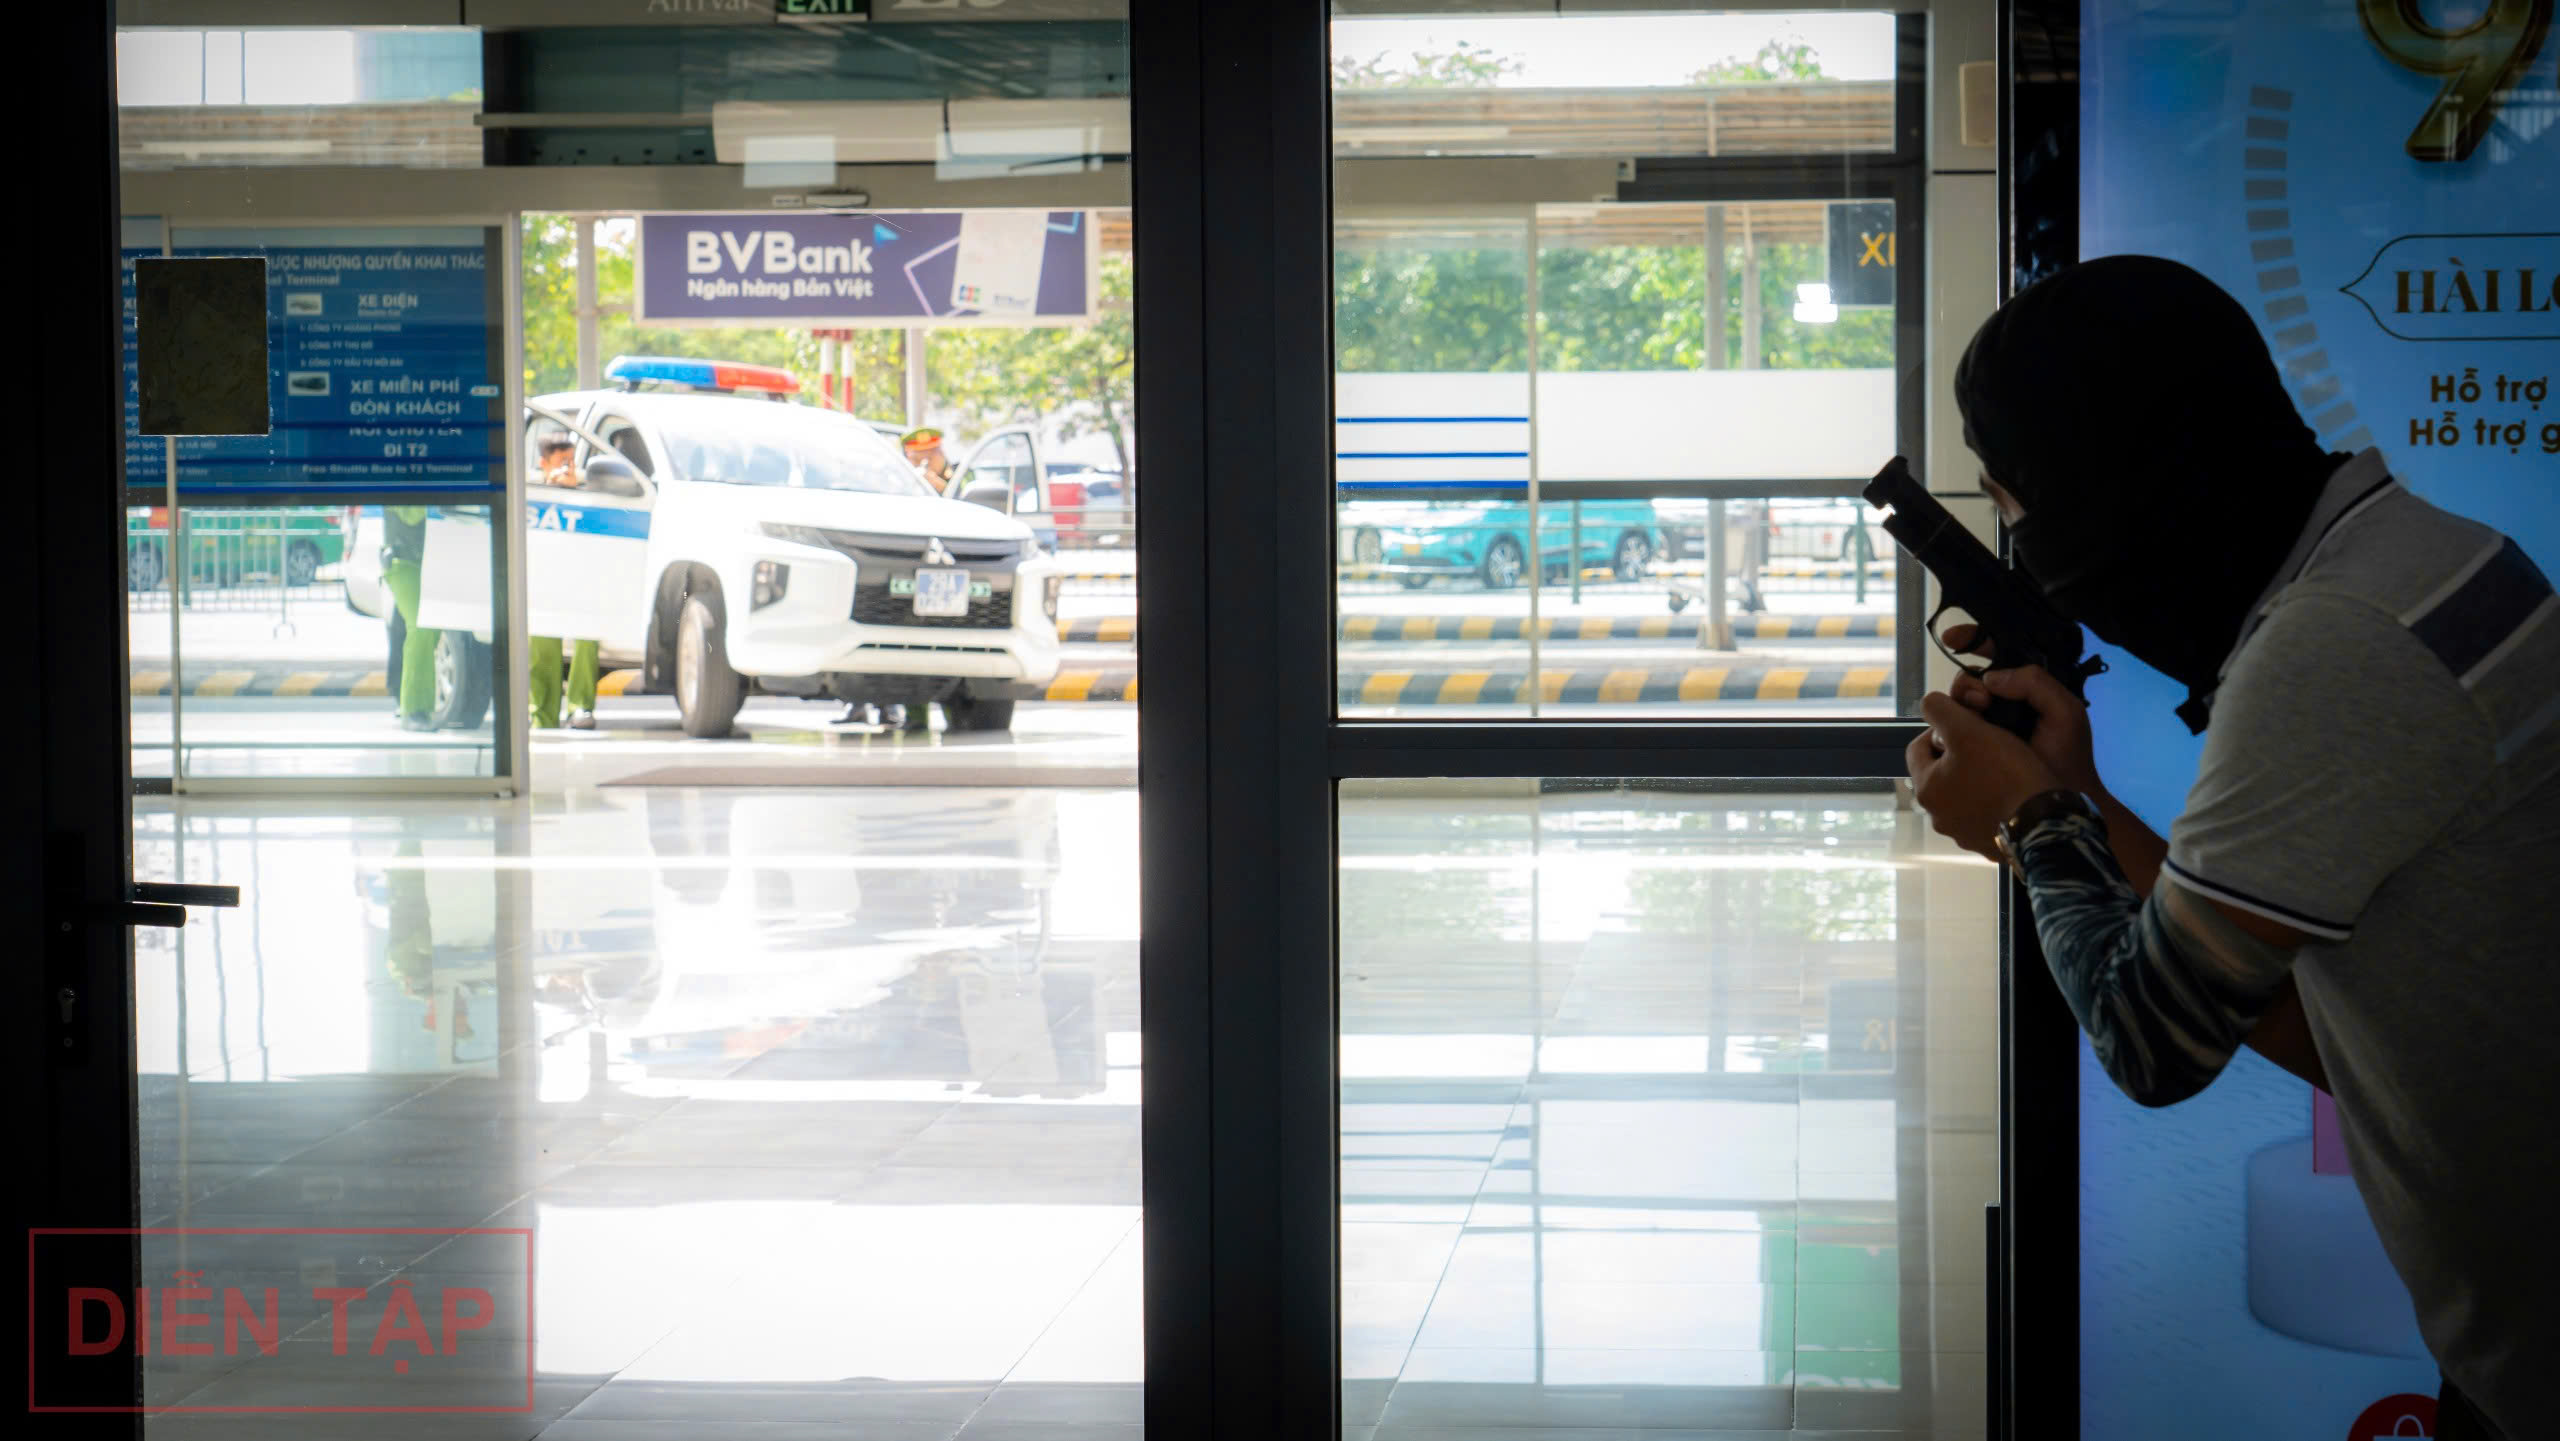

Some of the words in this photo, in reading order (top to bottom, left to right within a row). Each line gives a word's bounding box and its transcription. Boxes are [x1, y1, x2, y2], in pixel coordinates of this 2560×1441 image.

[787, 0, 854, 14] EXIT
[364, 250, 411, 271] QUYỀN
[414, 254, 447, 270] KHAI
[449, 251, 485, 270] THÁC
[687, 231, 873, 274] BVBank
[687, 277, 739, 300] Ngân
[742, 277, 790, 300] hàng
[793, 276, 831, 297] Bản
[833, 278, 873, 300] Việt
[2394, 256, 2502, 313] HÀI
[2516, 268, 2560, 313] L
[358, 294, 377, 308] XE
[350, 379, 374, 394] XE
[379, 375, 424, 394] MIỄN
[429, 377, 460, 394] PHÍ
[2431, 367, 2481, 403] Hỗ
[2496, 374, 2548, 411] trợ
[396, 399, 461, 416] KHÁCH
[2409, 411, 2461, 446] Hỗ
[2475, 418, 2527, 454] trợ
[406, 443, 429, 457] T2
